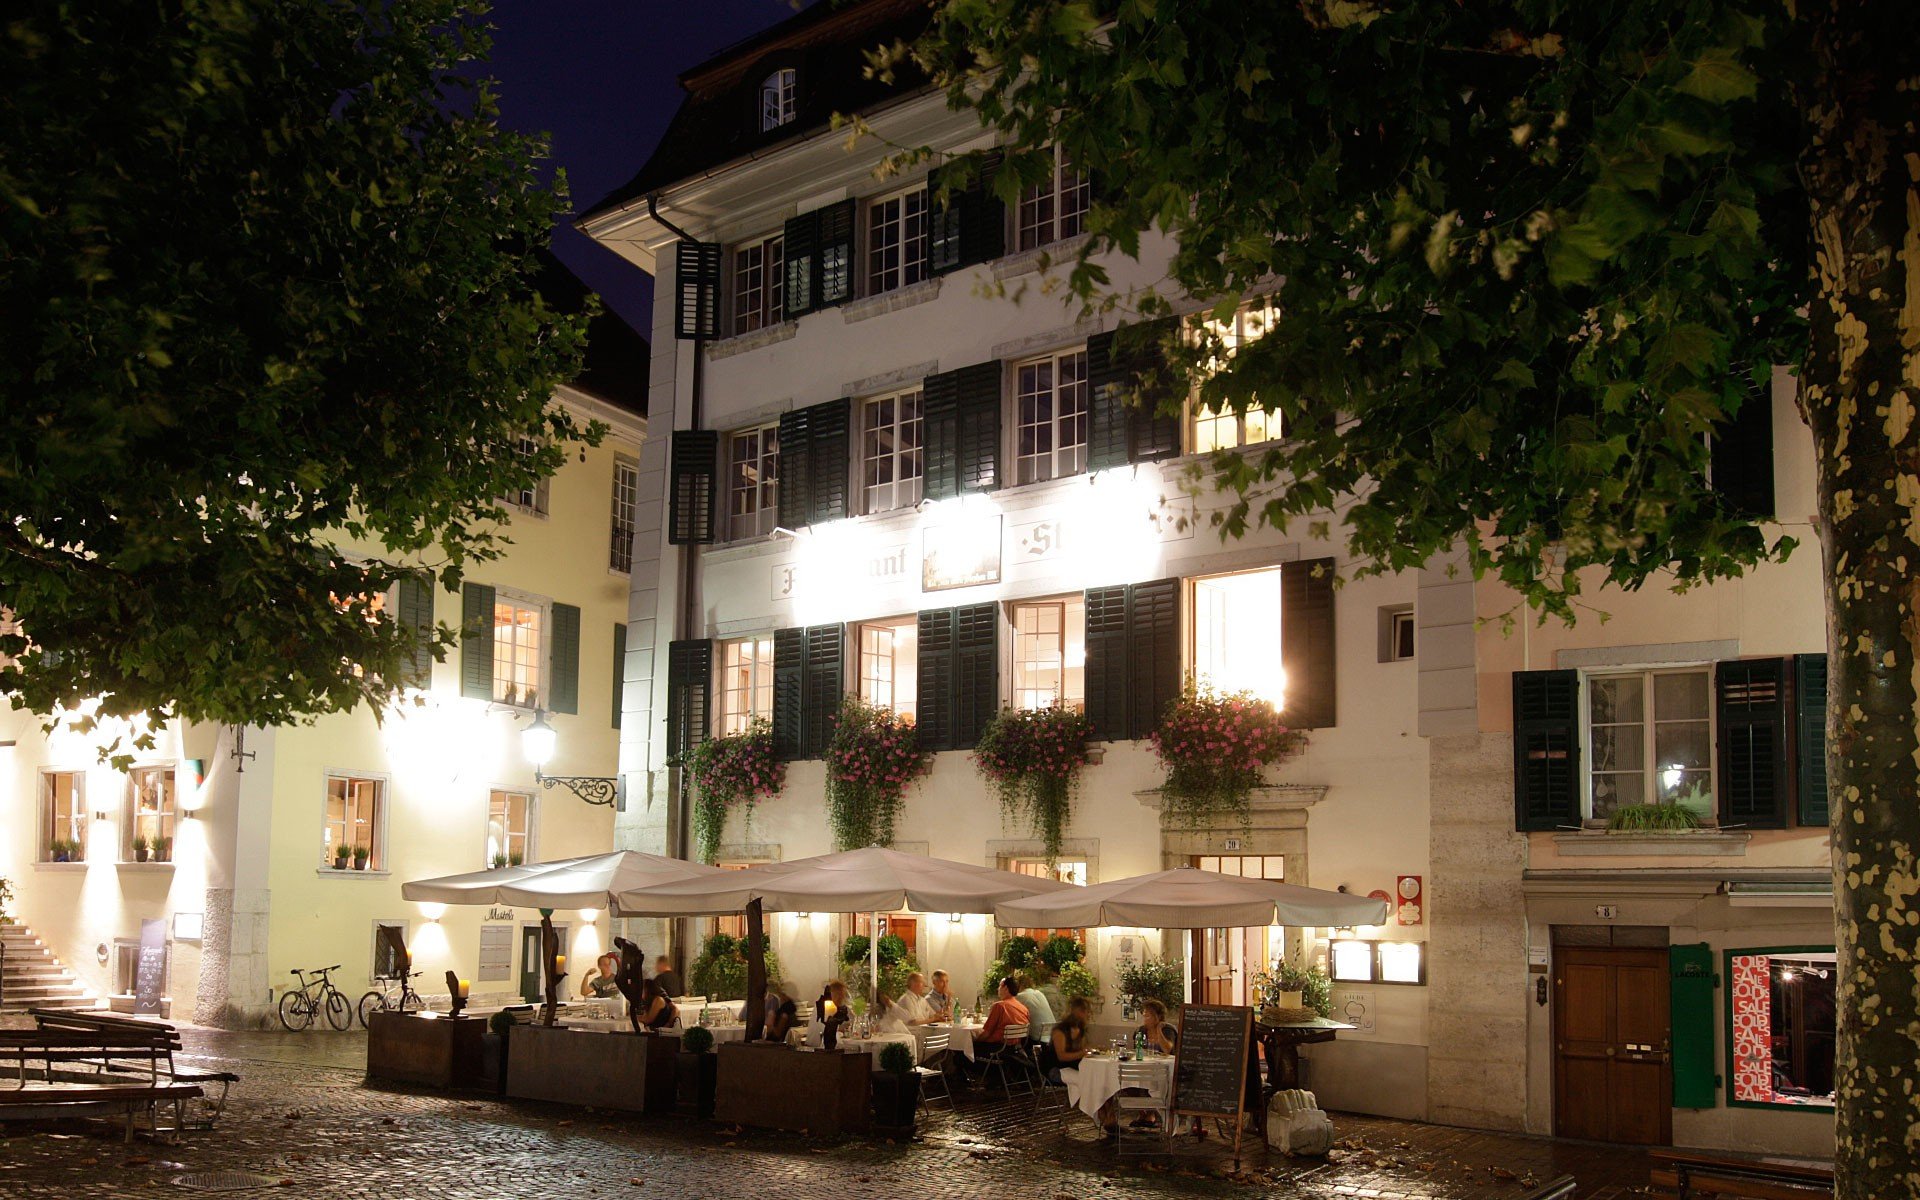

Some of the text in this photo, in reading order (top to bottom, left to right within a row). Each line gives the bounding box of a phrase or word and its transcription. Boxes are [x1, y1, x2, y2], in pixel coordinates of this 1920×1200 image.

[1604, 906, 1610, 917] 8
[1738, 1000, 1770, 1015] SALE
[1739, 1060, 1771, 1075] SALE
